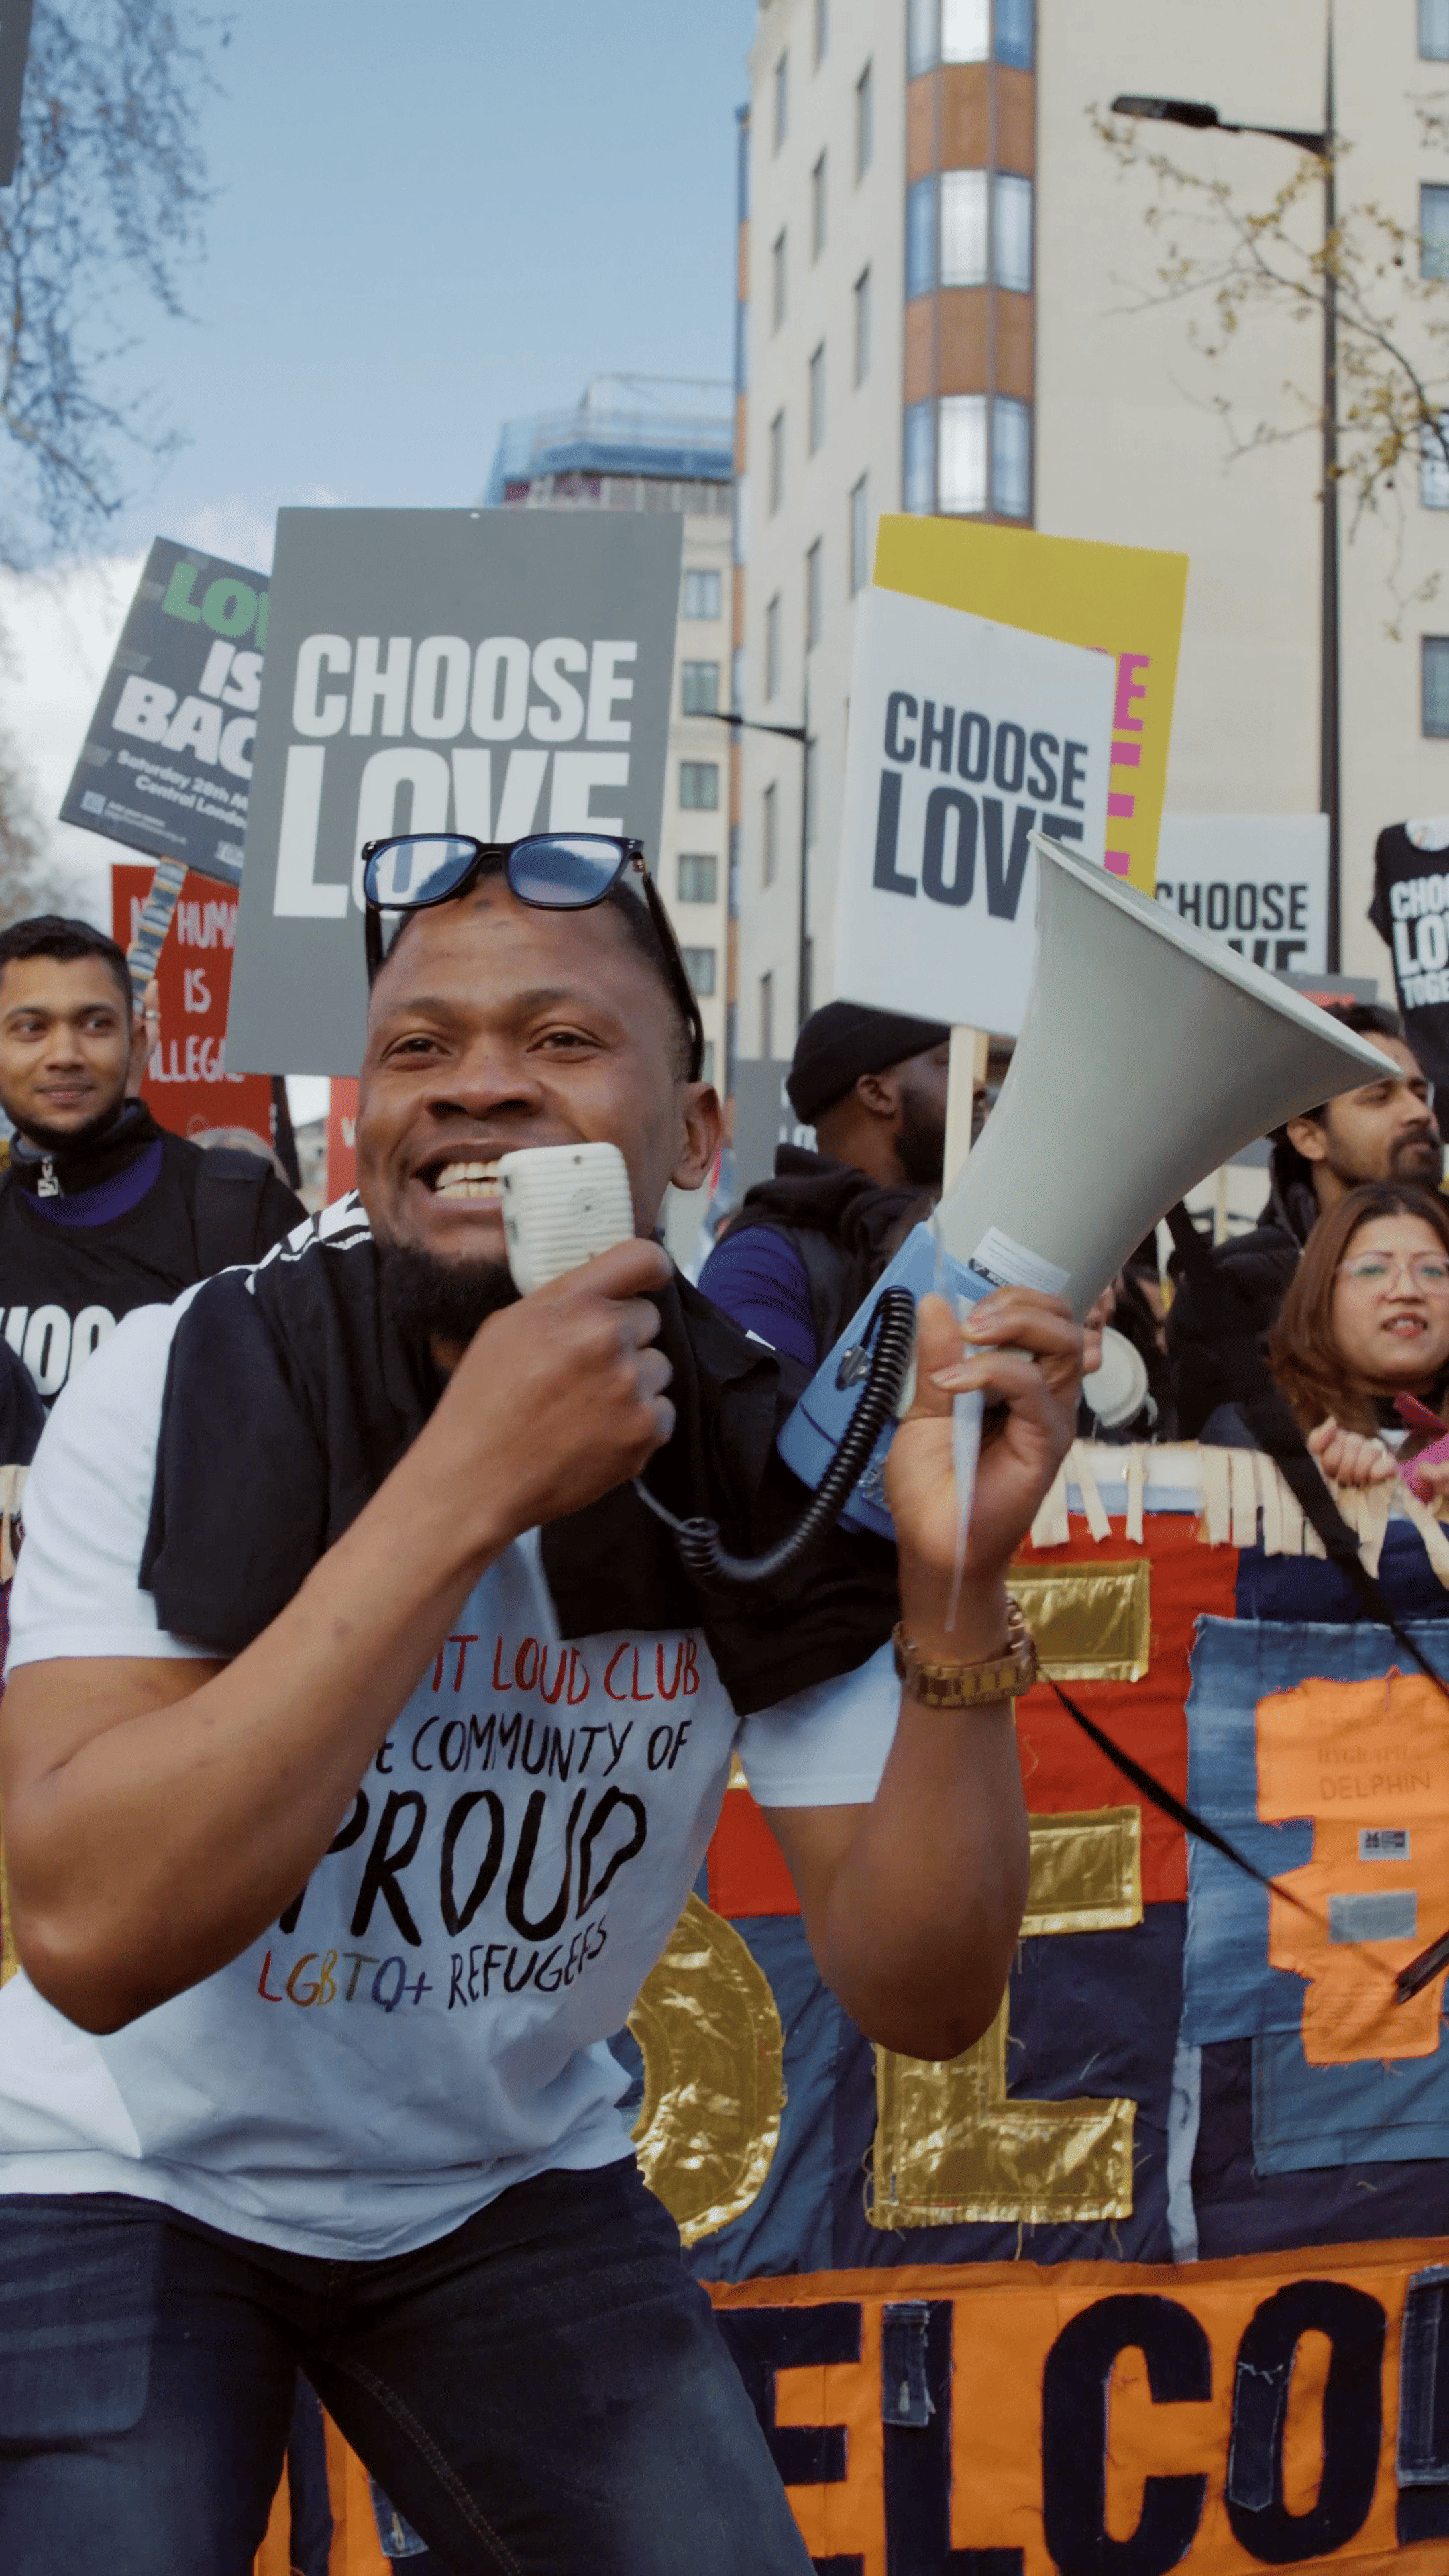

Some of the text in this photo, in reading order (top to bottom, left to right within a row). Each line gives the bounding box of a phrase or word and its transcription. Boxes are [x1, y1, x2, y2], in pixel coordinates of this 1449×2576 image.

[162, 561, 270, 649] LO
[199, 639, 264, 712] IS
[292, 633, 638, 742] CHOOSE
[117, 749, 191, 790] Saturday
[884, 691, 1089, 810] CHOOSE
[1389, 873, 1449, 921] CHO
[1393, 912, 1449, 977] LO
[184, 968, 211, 1014] IS
[431, 1633, 700, 1705] IT LOUD CLUB
[647, 1720, 693, 1771] OF
[1320, 1770, 1431, 1801] DELPHIN
[257, 1949, 433, 2012] LGBTQ+
